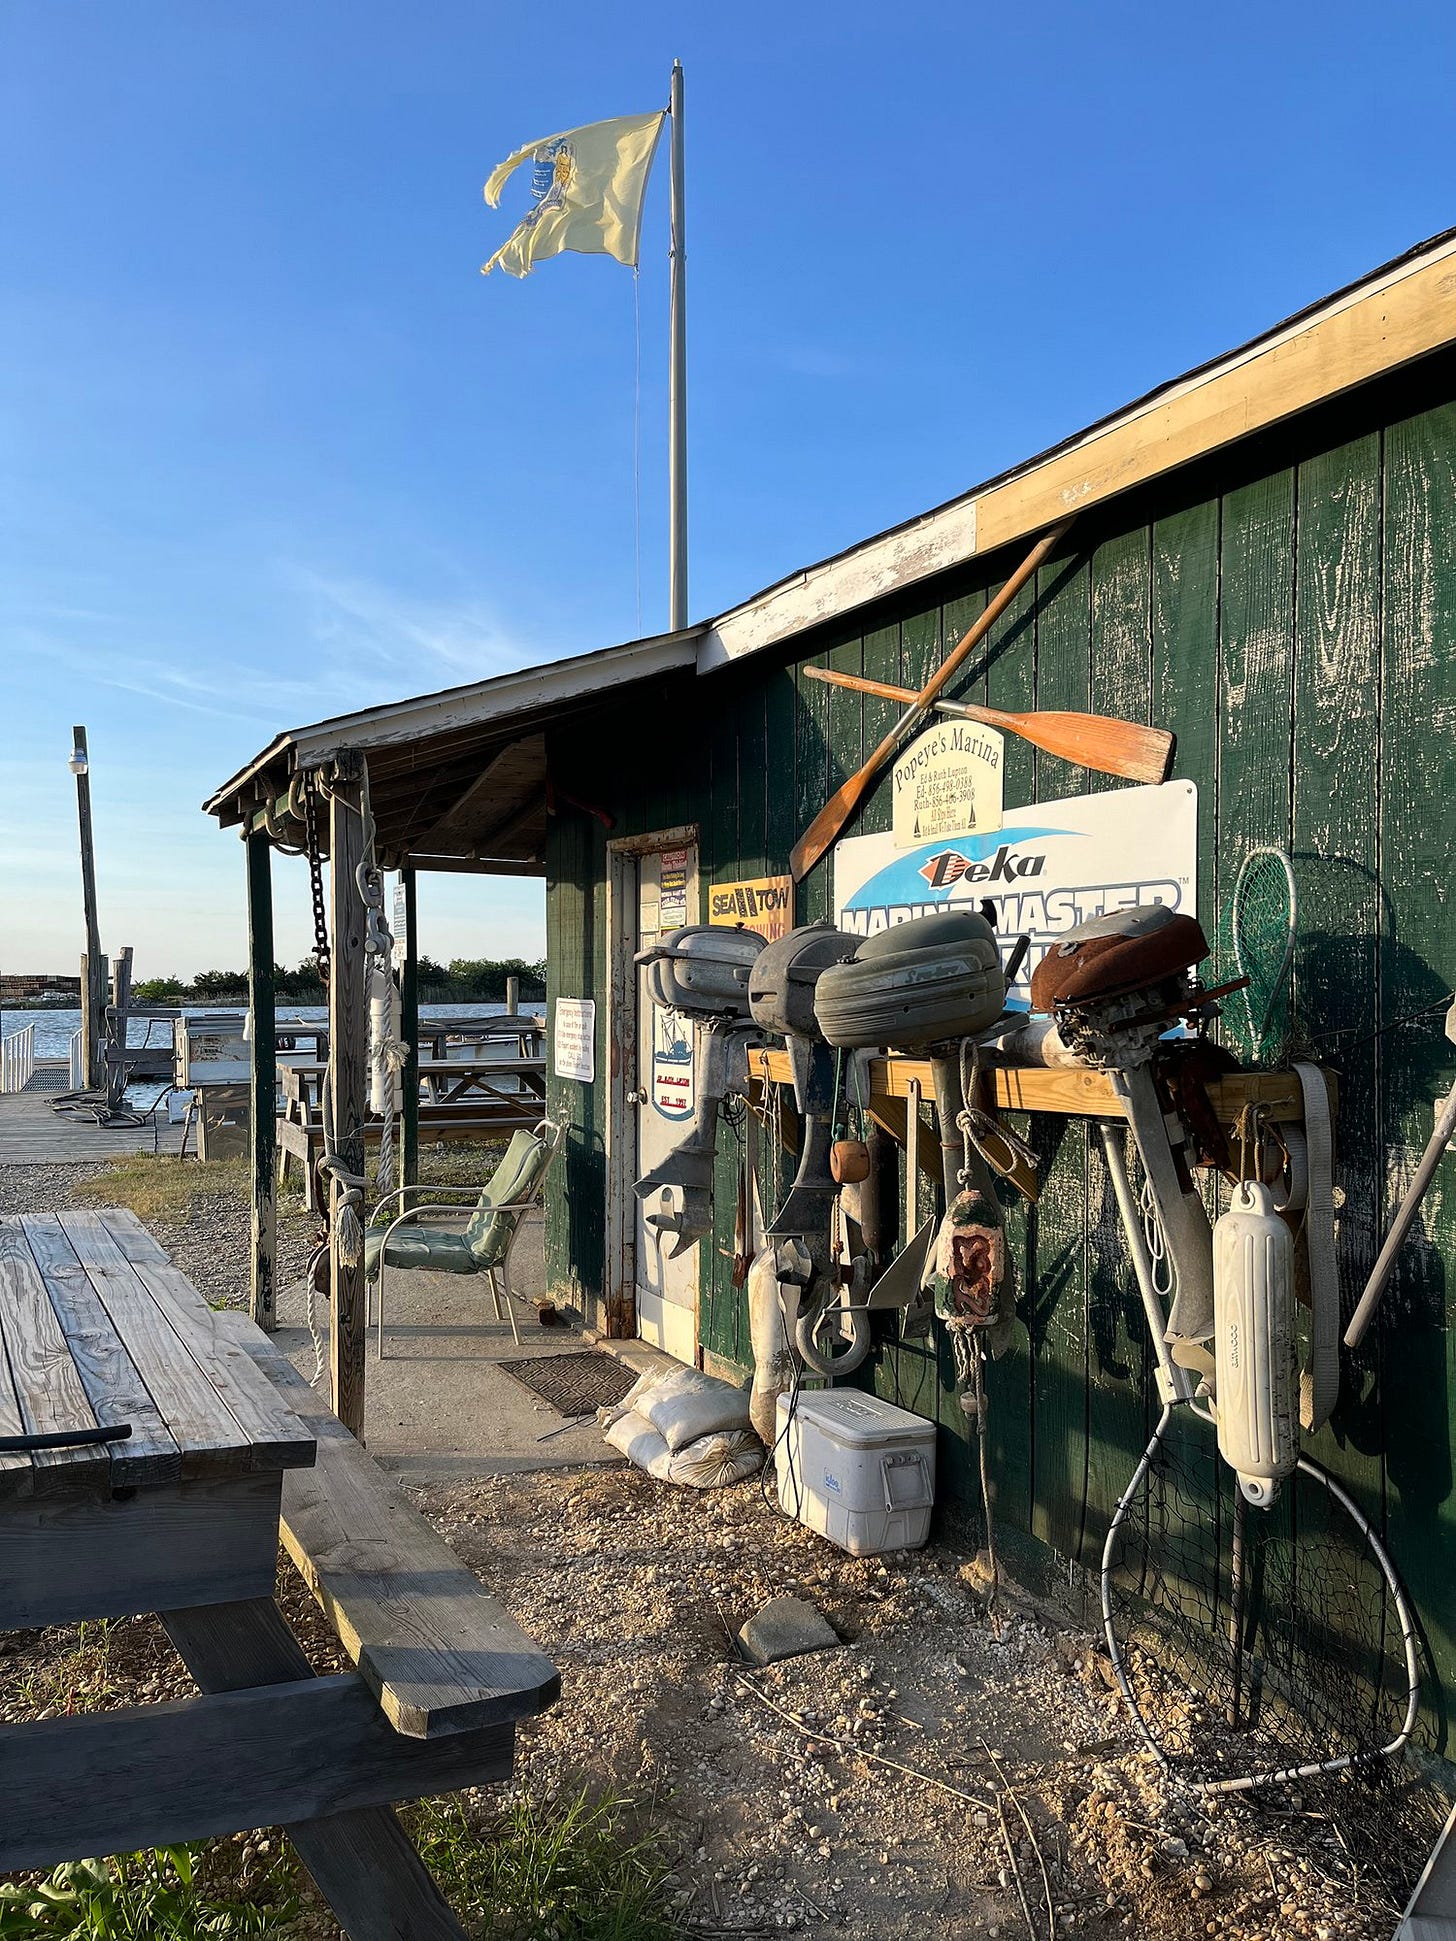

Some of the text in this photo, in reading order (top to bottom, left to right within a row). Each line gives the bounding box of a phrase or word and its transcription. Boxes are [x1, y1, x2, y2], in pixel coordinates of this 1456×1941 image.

[895, 728, 999, 793] Popeye's Marina
[929, 846, 1046, 887] Deka
[712, 893, 737, 916] SEA
[755, 886, 789, 911] TOW
